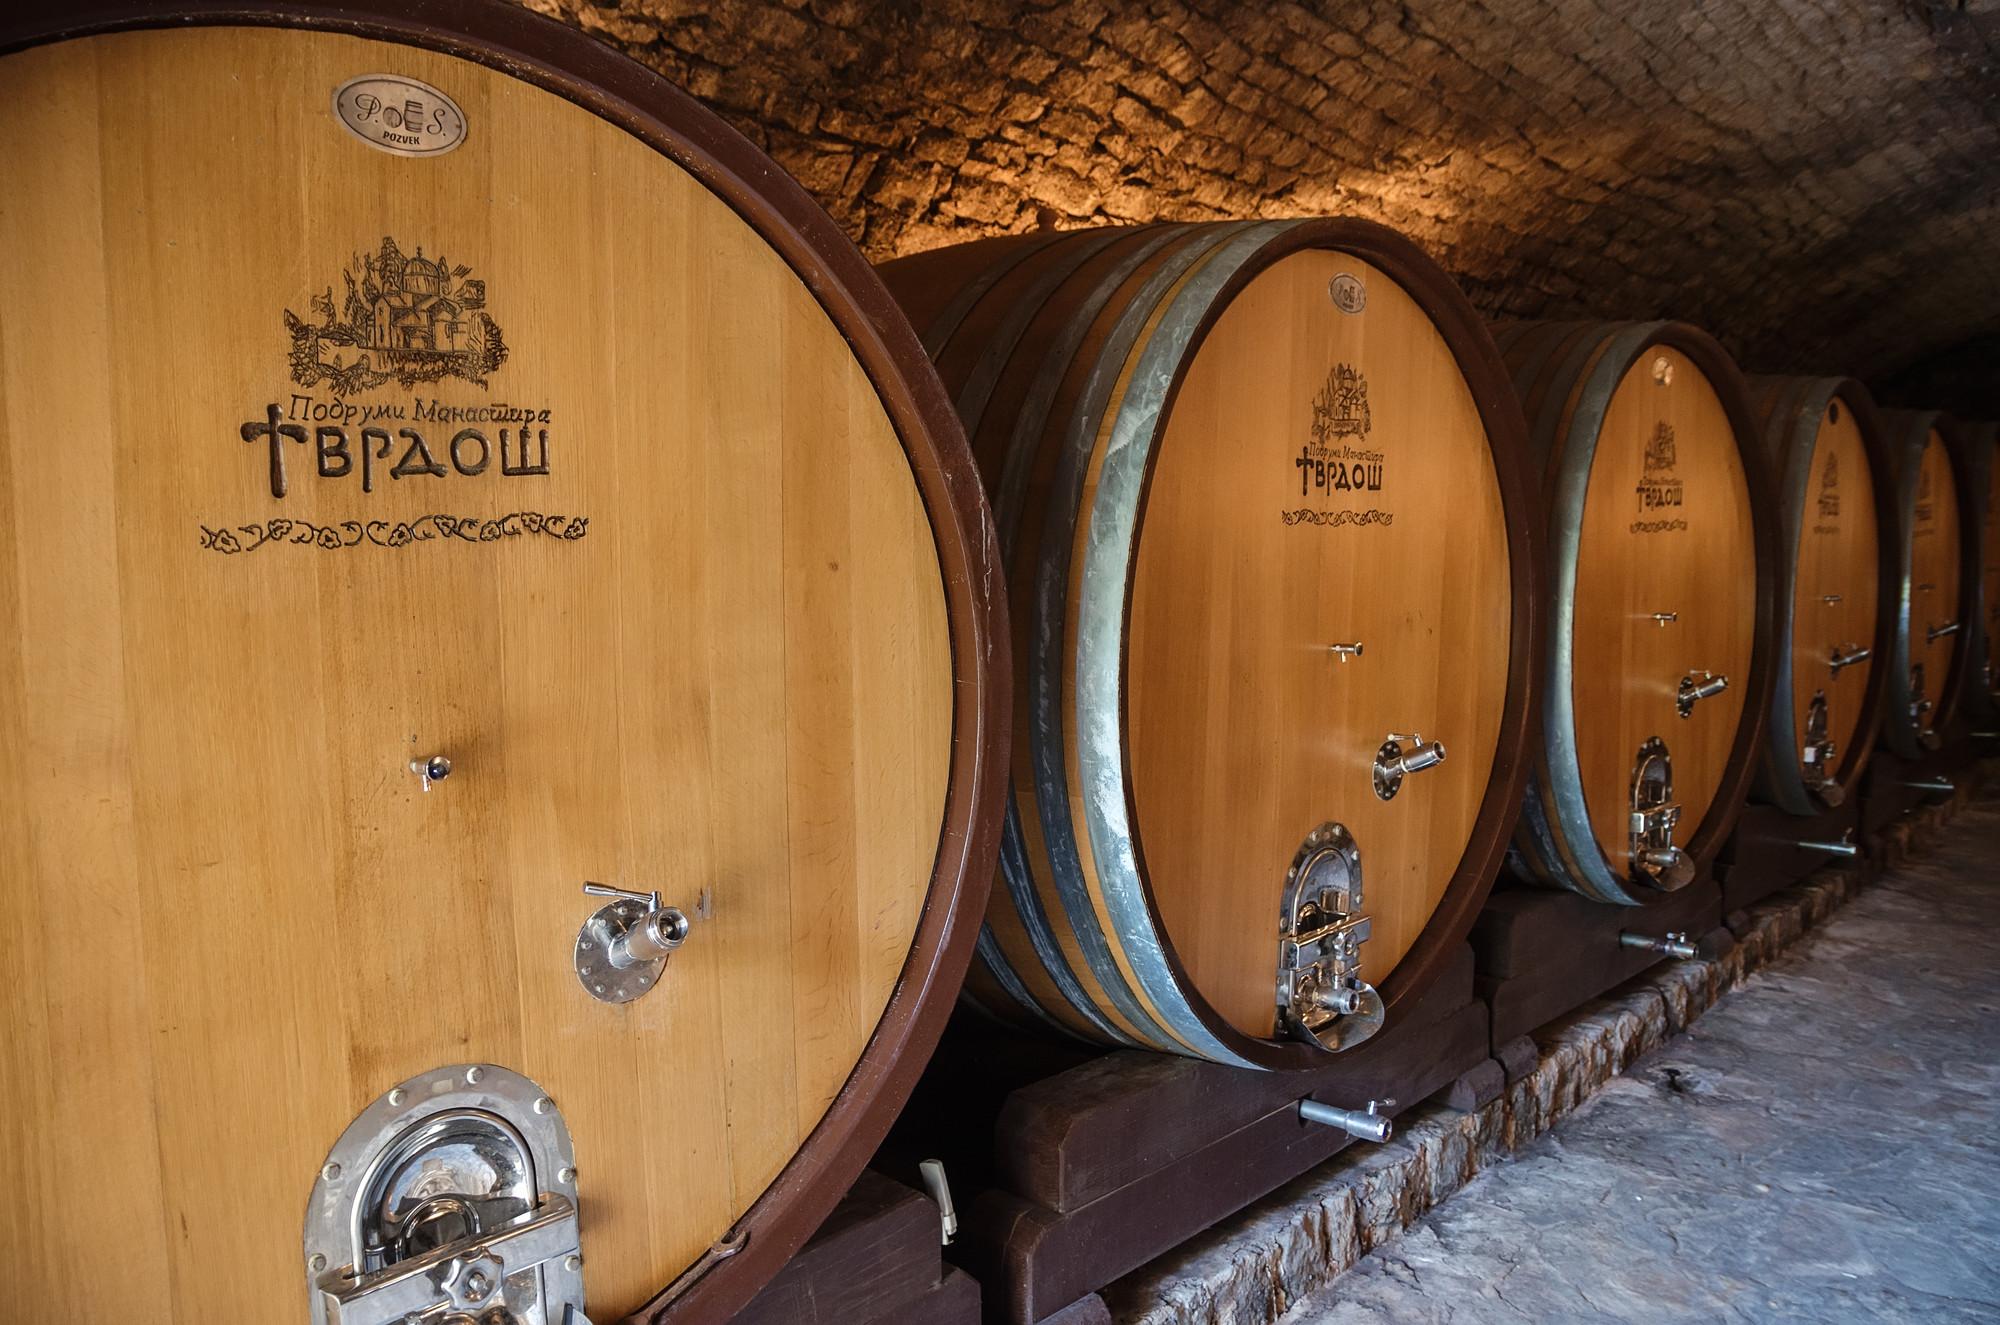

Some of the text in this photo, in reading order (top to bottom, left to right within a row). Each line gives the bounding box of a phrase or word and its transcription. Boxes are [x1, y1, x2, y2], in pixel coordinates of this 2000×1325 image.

[382, 131, 420, 145] POZVEK
[288, 394, 551, 431] Подруми Манастира
